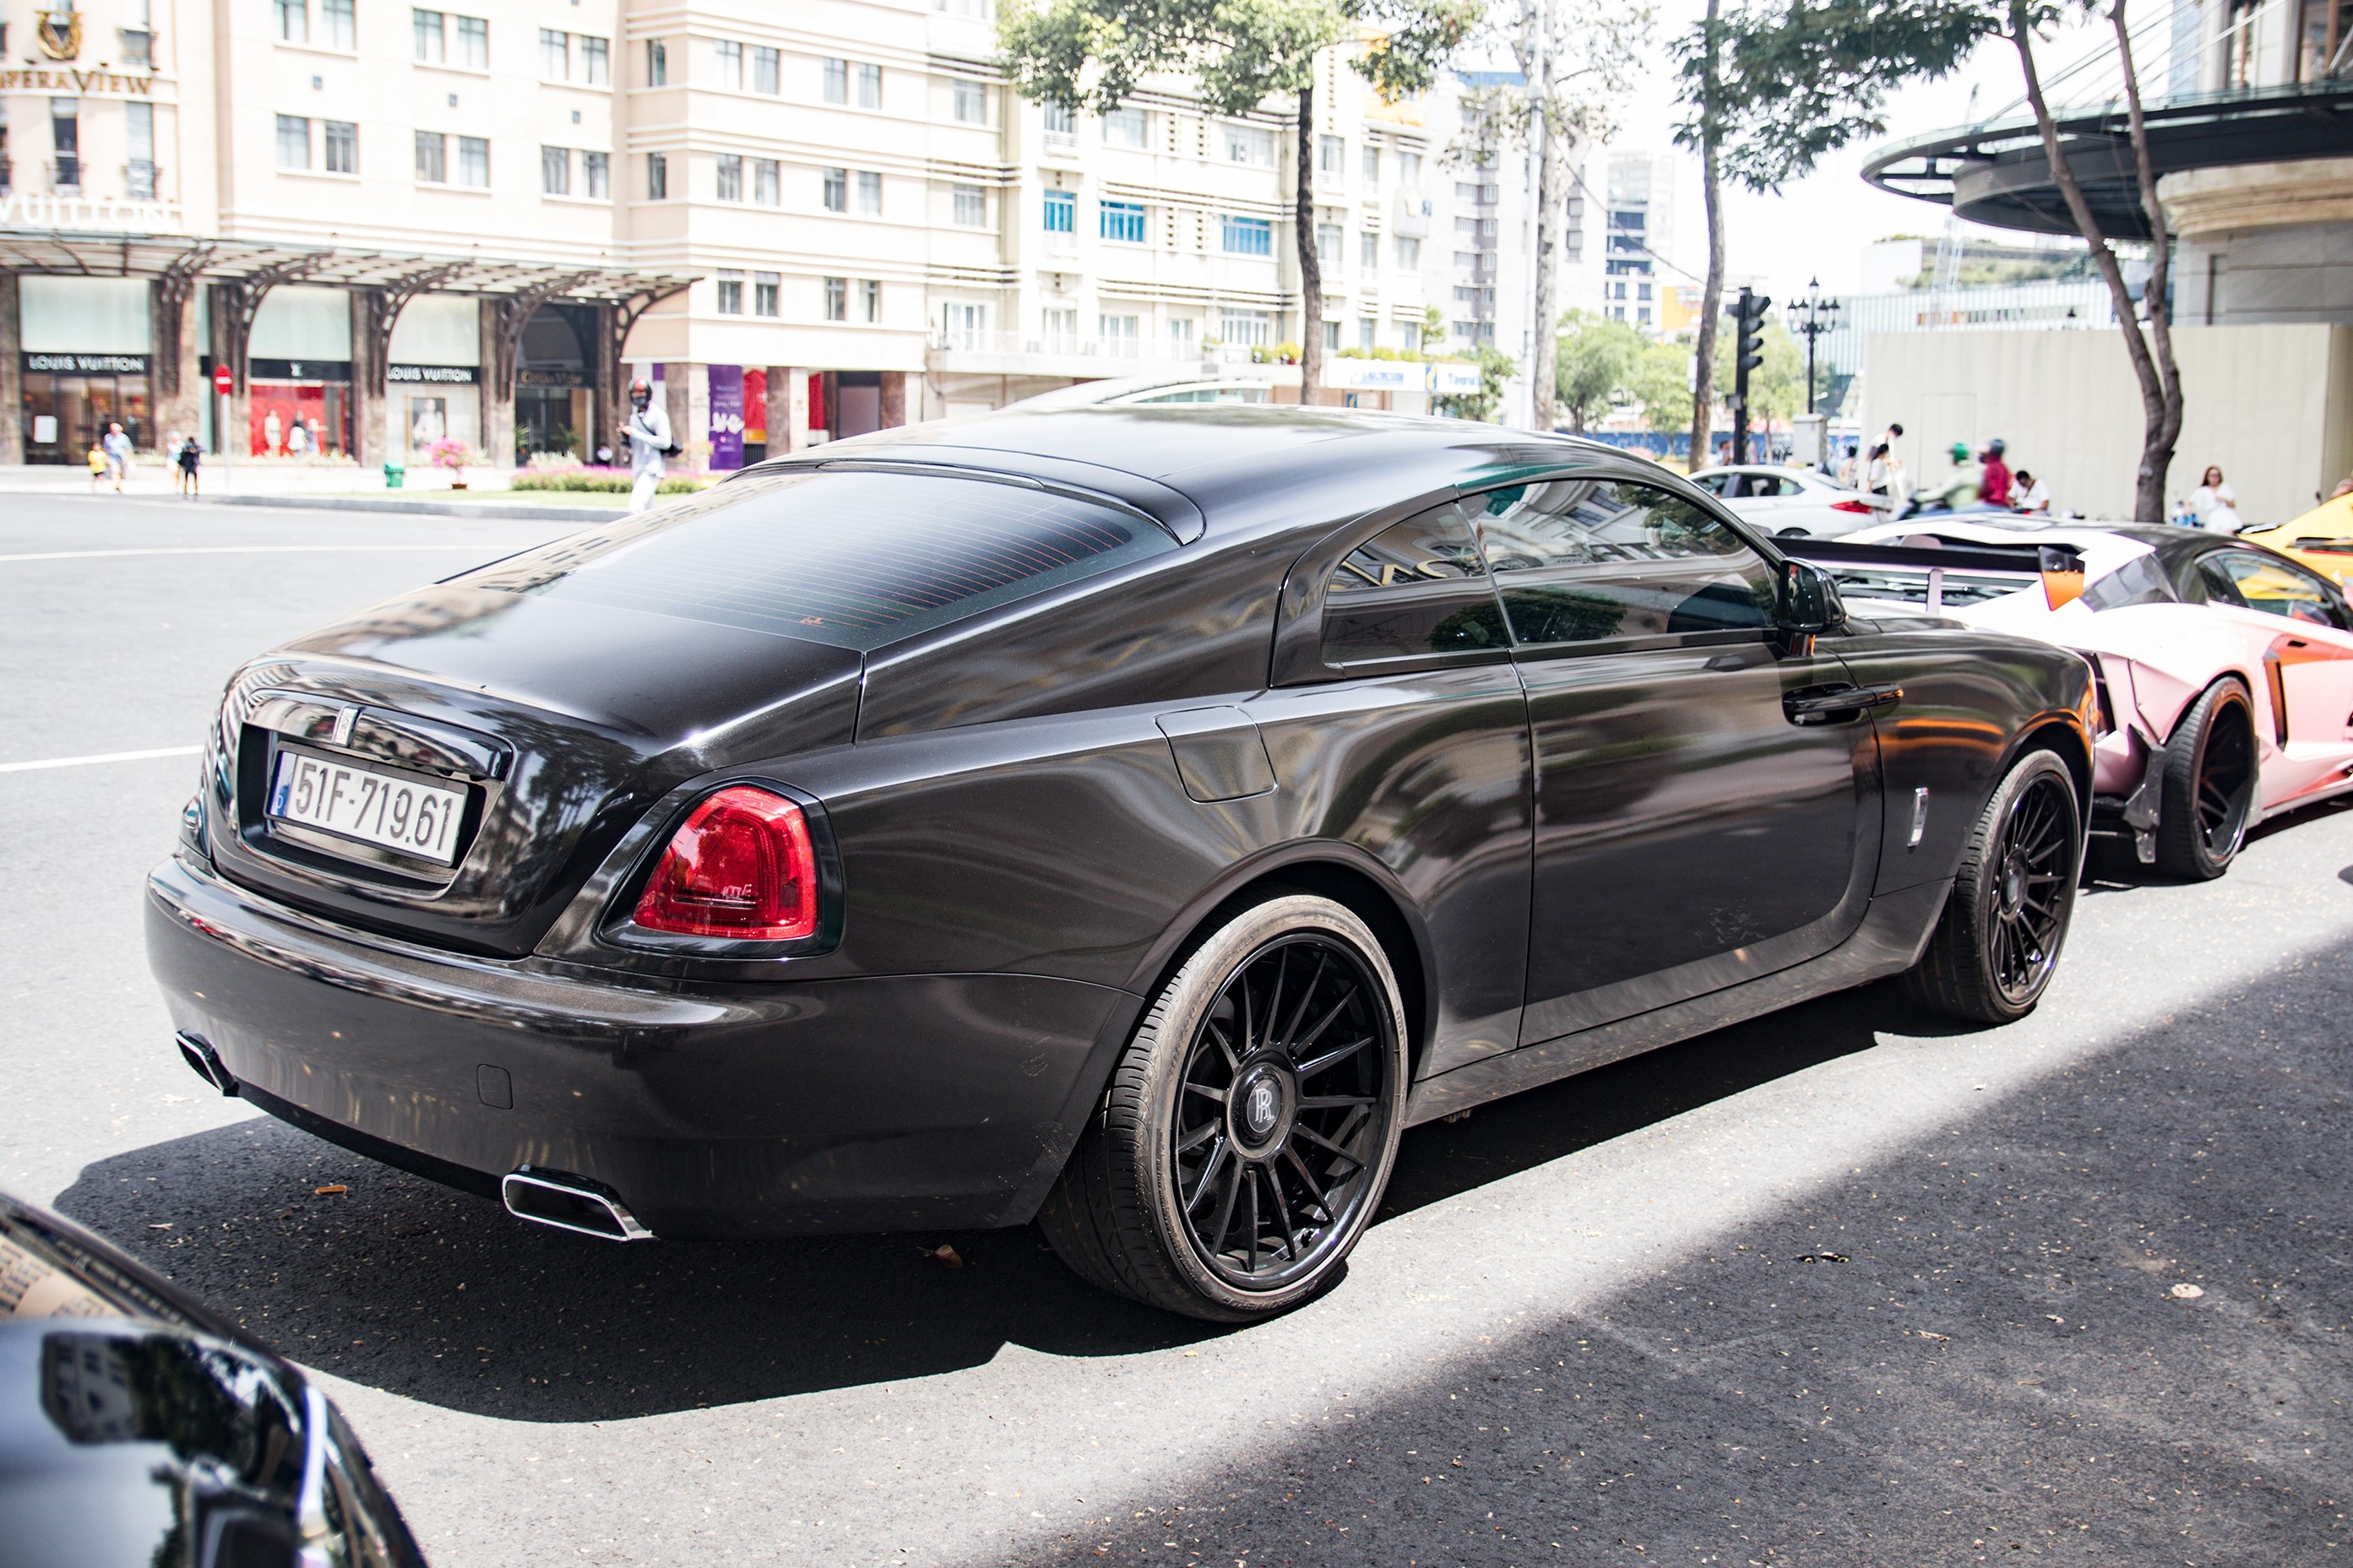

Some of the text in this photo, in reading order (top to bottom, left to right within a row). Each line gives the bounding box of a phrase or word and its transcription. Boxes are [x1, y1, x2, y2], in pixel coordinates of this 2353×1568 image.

[0, 68, 153, 95] PERA VIEW
[29, 355, 144, 372] LOUIS VUITTON
[387, 366, 472, 383] LOUIS VUITTON
[295, 762, 454, 852] 51F-719.61
